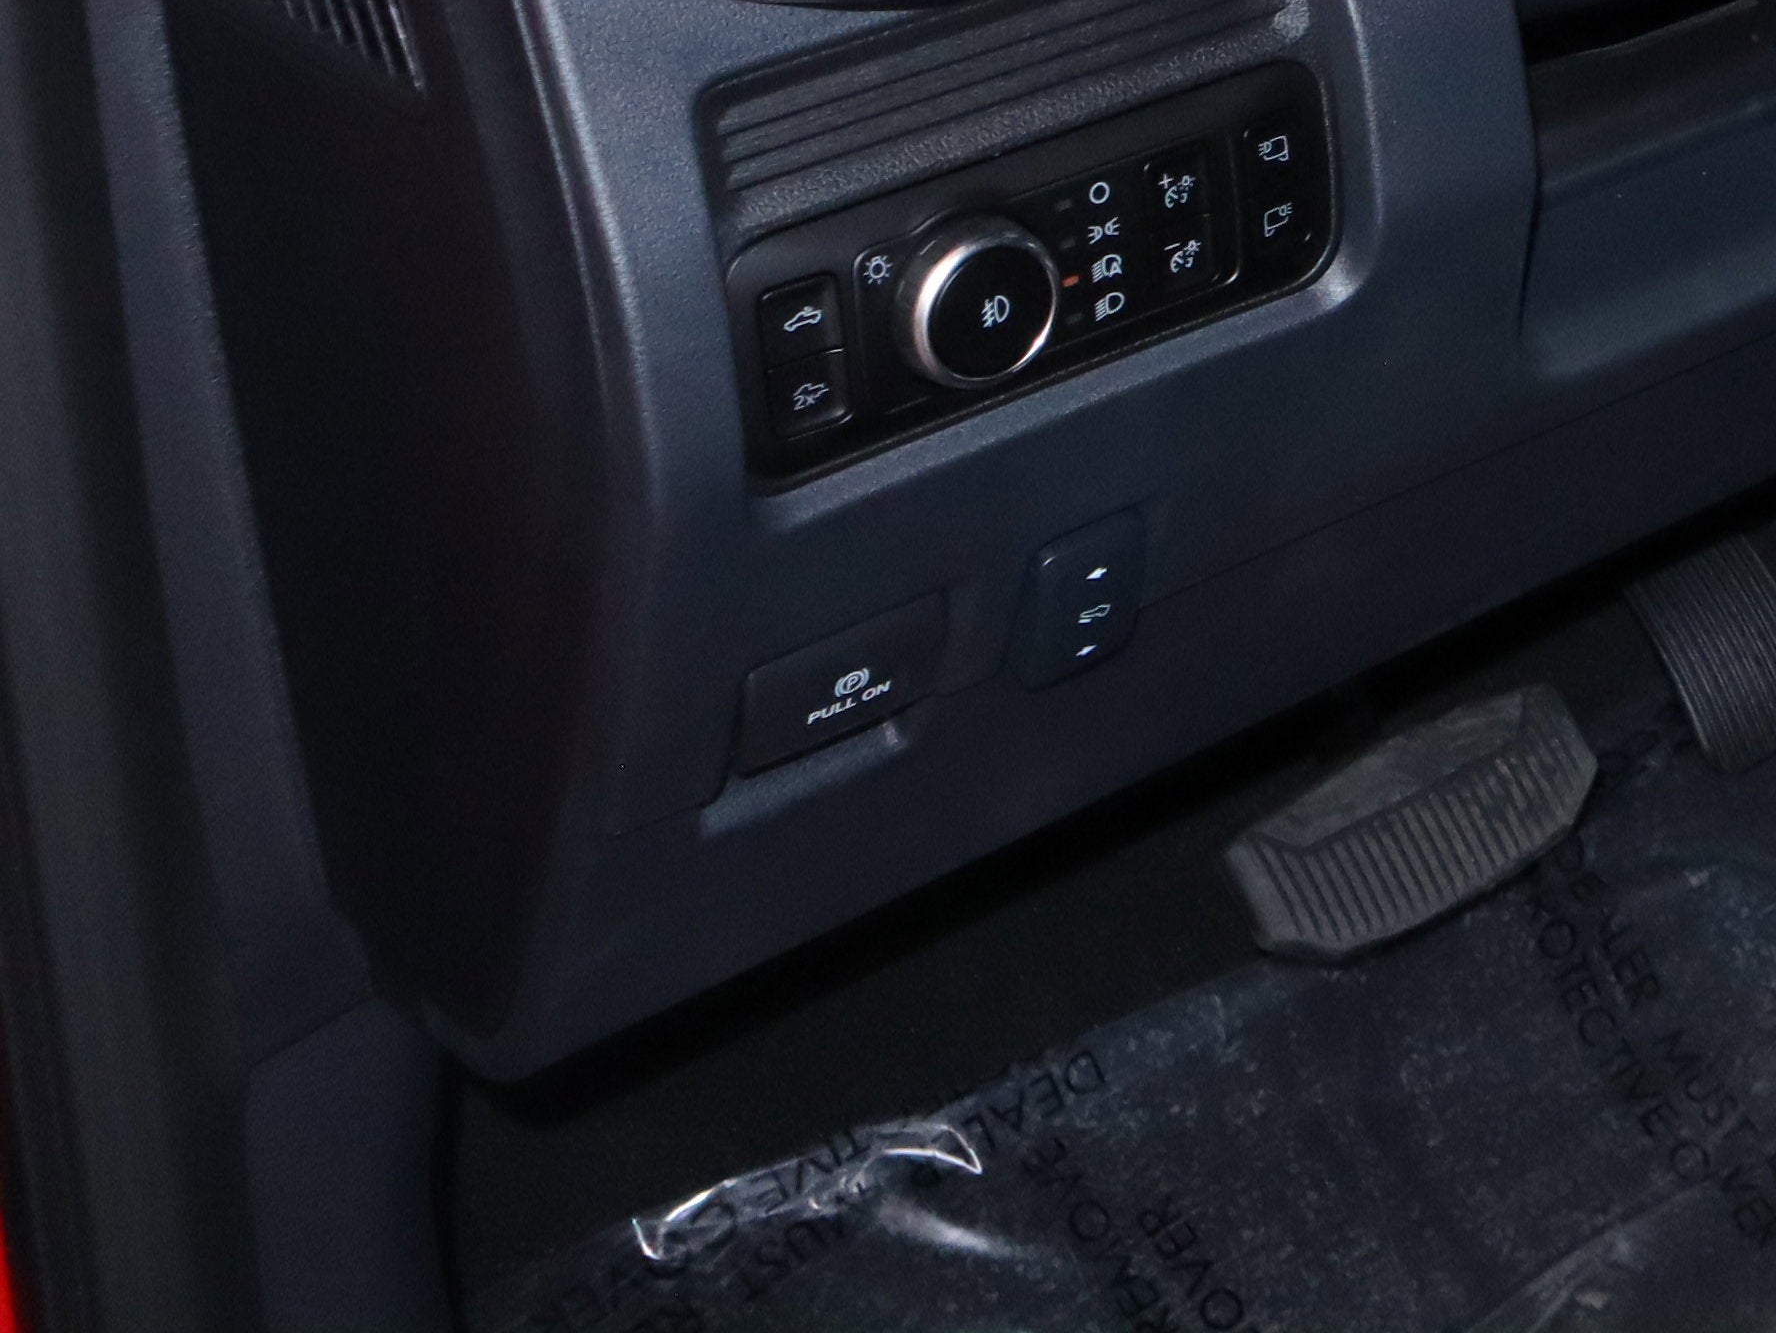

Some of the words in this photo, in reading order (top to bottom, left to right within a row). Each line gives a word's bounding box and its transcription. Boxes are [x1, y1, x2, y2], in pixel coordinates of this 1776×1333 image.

[807, 698, 857, 726] PULL
[862, 681, 891, 701] ON
[1527, 889, 1681, 1137] ROTECTIVE
[1655, 1029, 1757, 1134] MUST
[1138, 1194, 1245, 1331] OVER
